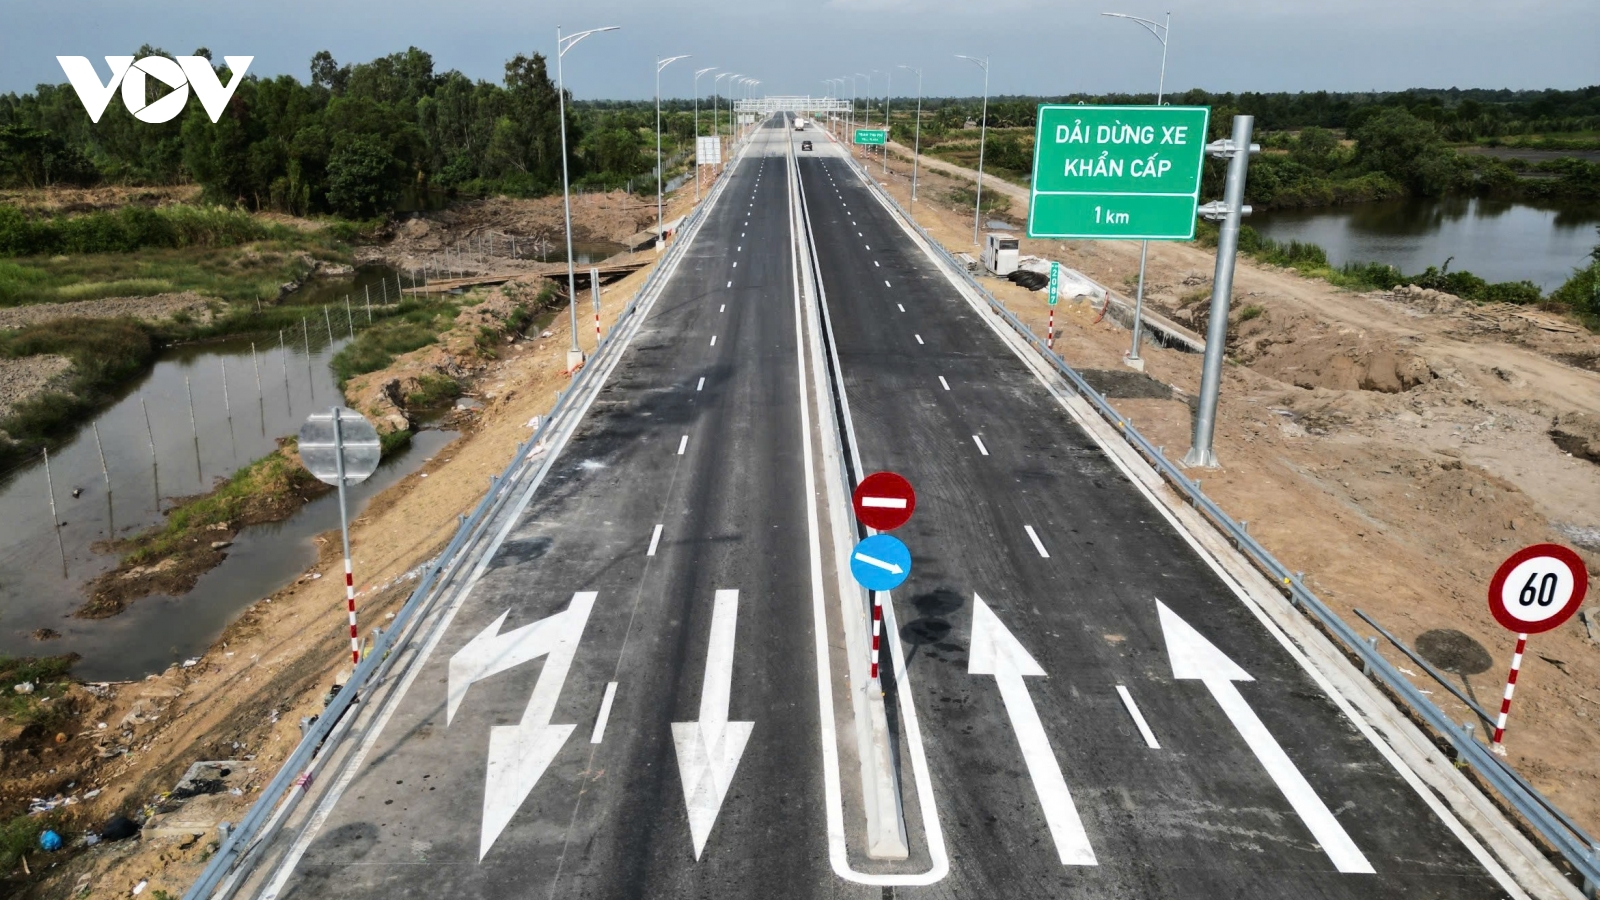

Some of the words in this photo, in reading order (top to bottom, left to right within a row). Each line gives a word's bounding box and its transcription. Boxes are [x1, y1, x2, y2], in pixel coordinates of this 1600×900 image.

[1055, 119, 1090, 144] DẢI
[1096, 119, 1155, 145] DỪNG
[1160, 126, 1188, 145] XE
[1064, 150, 1124, 177] KHẨN
[1130, 152, 1172, 178] CẤP
[1094, 206, 1102, 224] 1
[1105, 209, 1130, 224] km
[1519, 572, 1558, 607] 60
